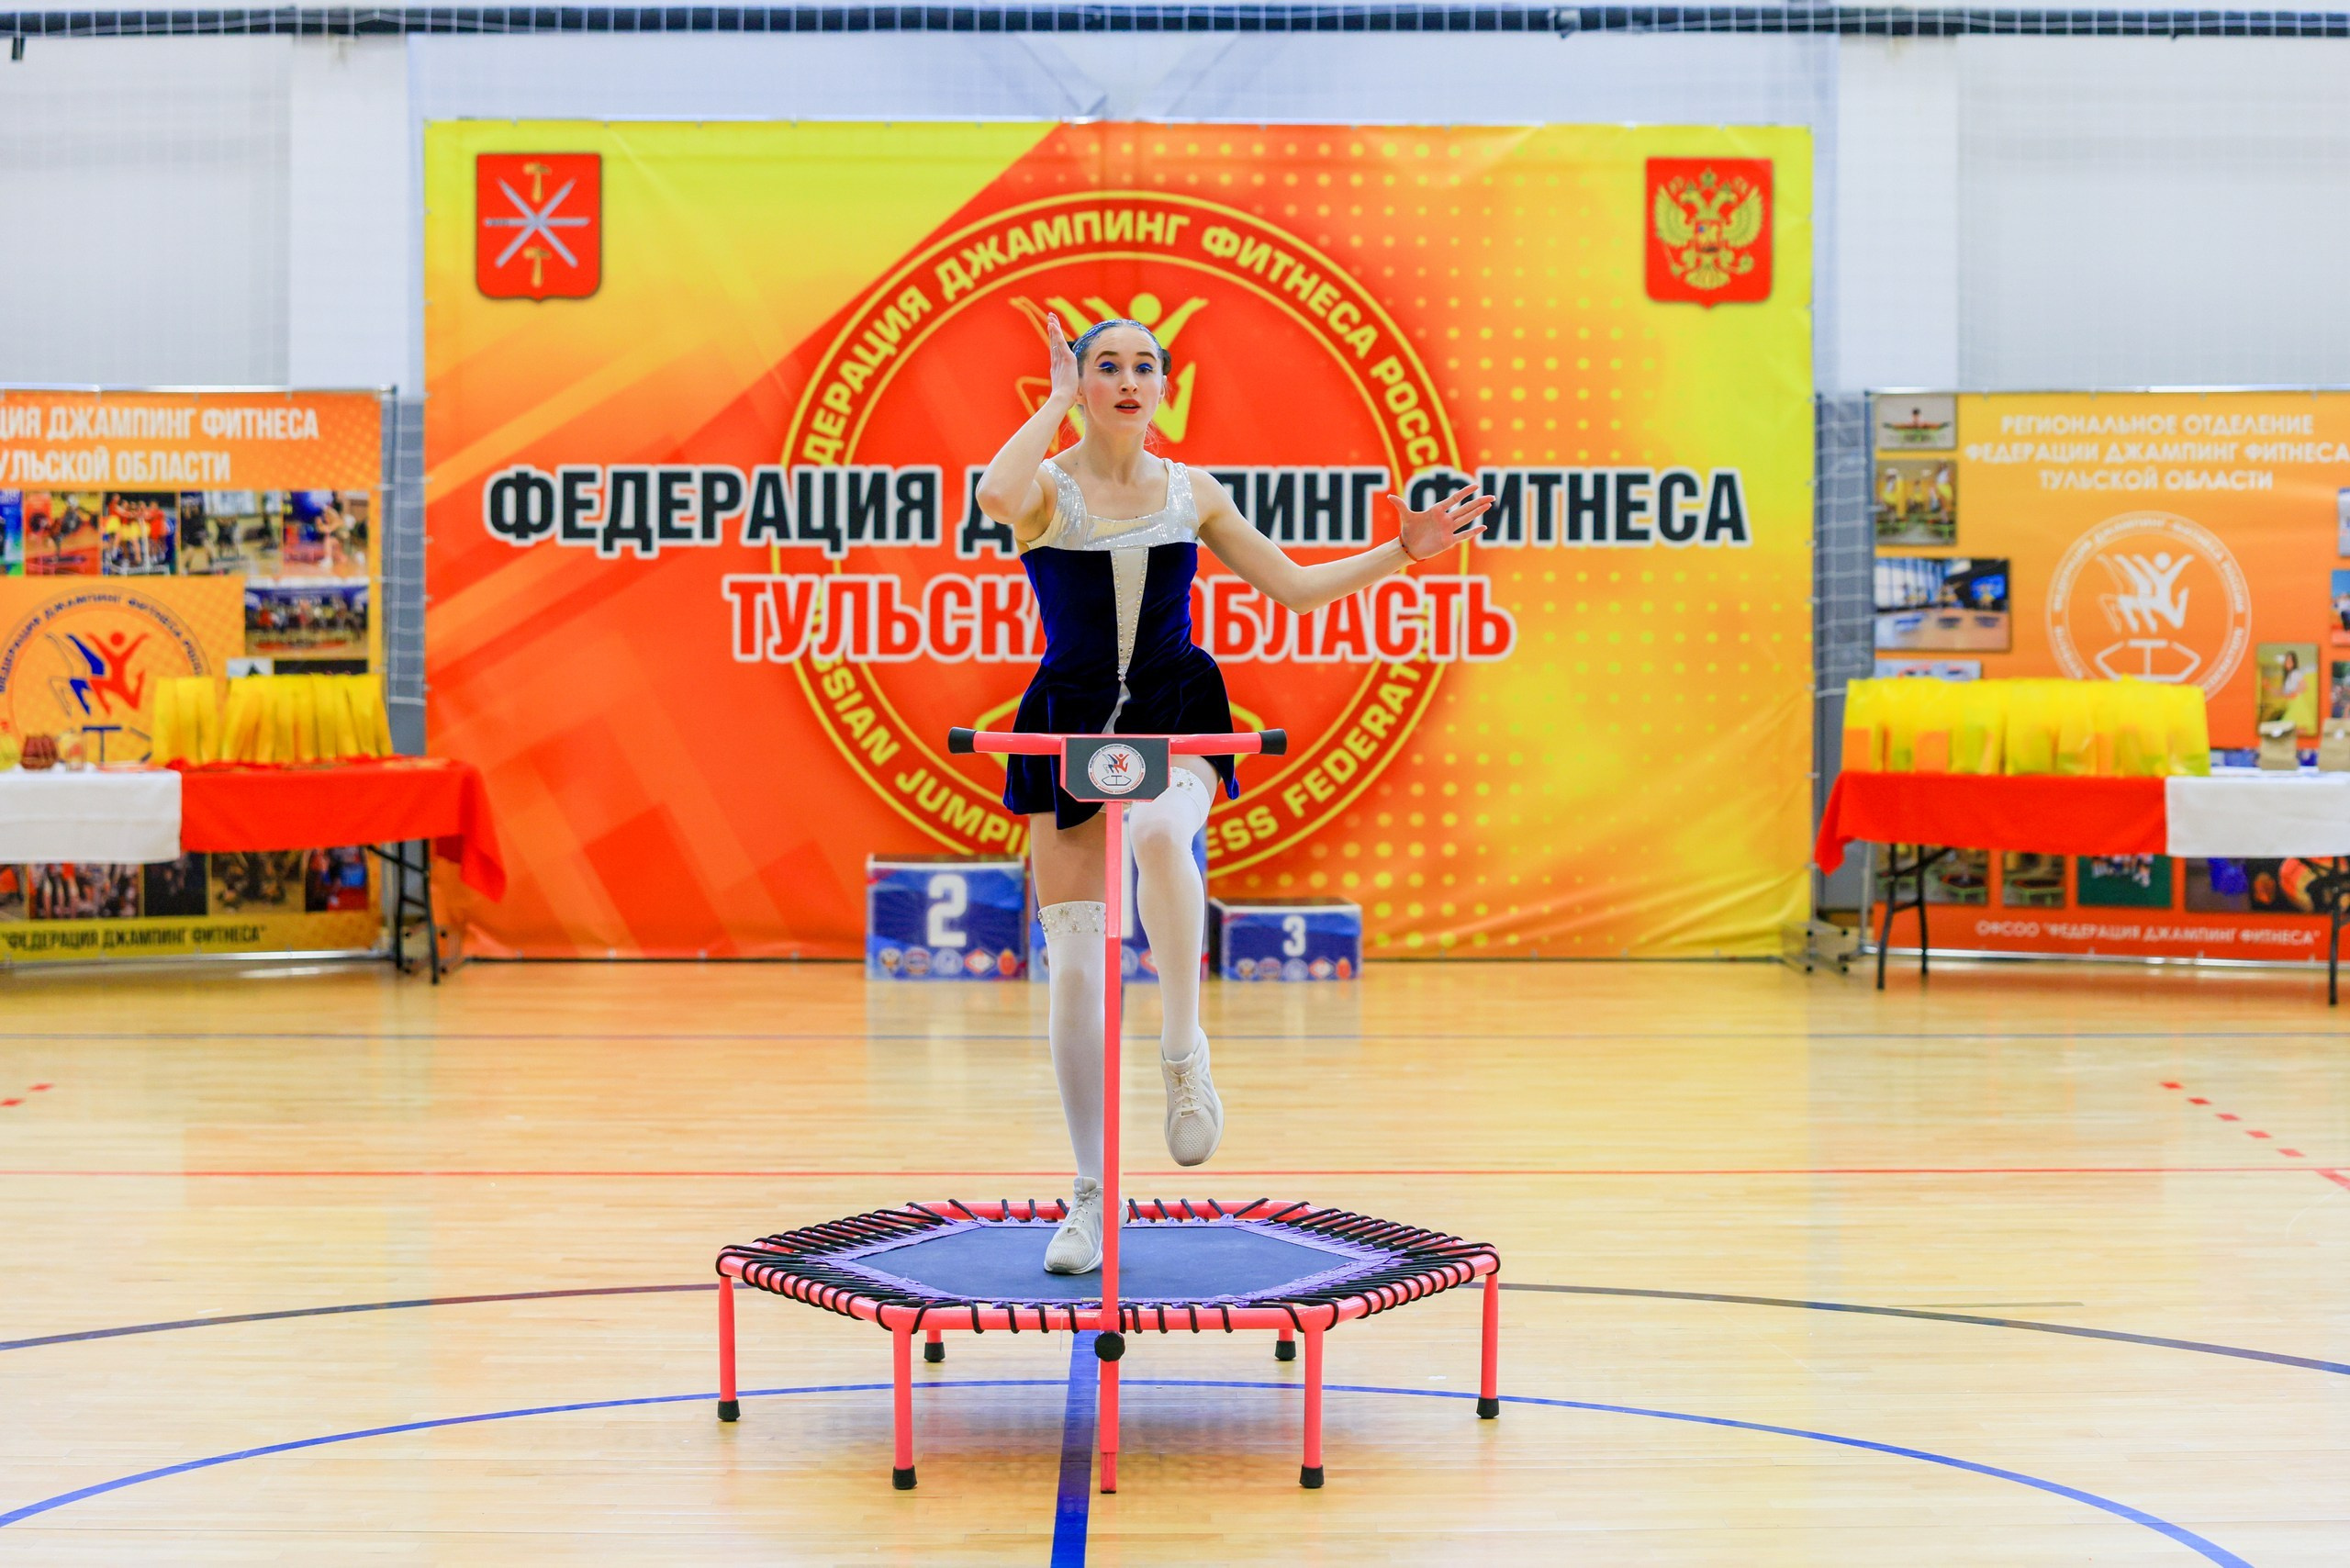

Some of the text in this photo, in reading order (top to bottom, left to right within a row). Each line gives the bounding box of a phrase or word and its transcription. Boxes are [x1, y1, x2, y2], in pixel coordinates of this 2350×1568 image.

[802, 209, 1444, 471] ДЕРАЦИЯ ДЖАМПИНГ ФИТНЕСА РОСС
[47, 406, 196, 442] ДЖАМПИНГ
[201, 408, 320, 440] ФИТНЕСА
[2000, 414, 2314, 436] РЕГИОНАЛЬНОЕ ОТДЕЛЕНИЕ
[116, 450, 230, 483] ОБЛАСТИ
[1964, 442, 2350, 465] ФЕДЕРАЦИИ ДЖАМПИНГ ФИТНЕСА
[2039, 466, 2273, 491] ТУЛЬСКОЙ ОБЛАСТИ
[488, 468, 936, 554] ФЕДЕРАЦИЯ
[960, 470, 1386, 554] ДИНГ
[729, 578, 1512, 658] ТУЛЬСК БЛАСТЬ
[1281, 659, 1422, 818] FEDERAT
[894, 767, 1030, 857] JUMPI
[927, 873, 968, 947] 2
[1282, 915, 1306, 957] 3
